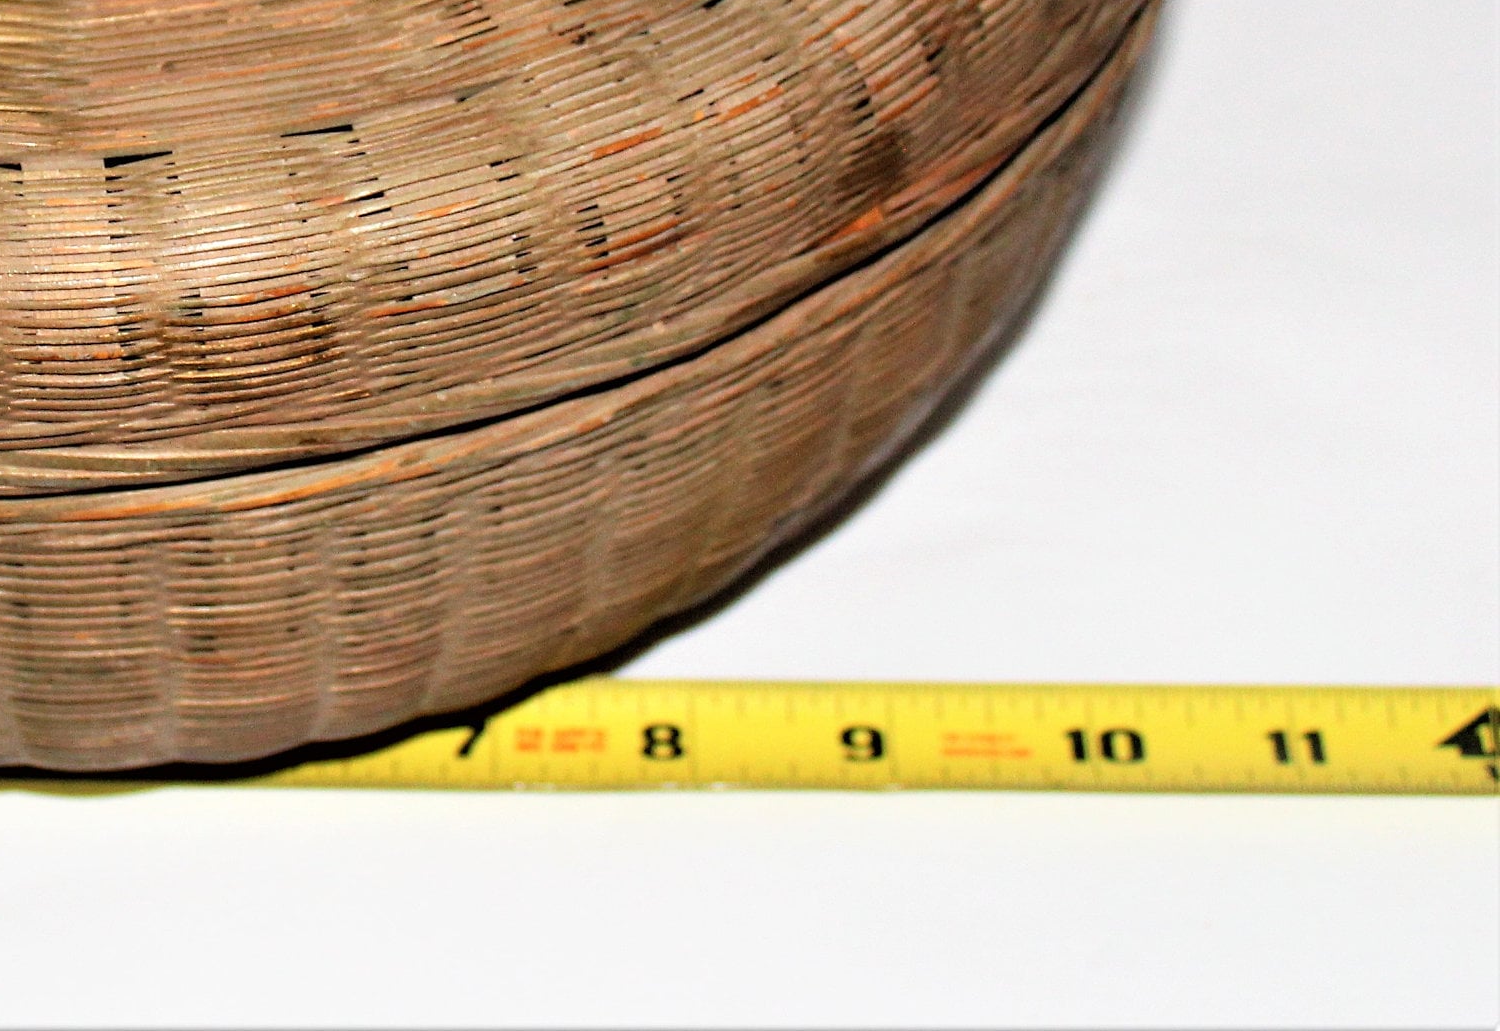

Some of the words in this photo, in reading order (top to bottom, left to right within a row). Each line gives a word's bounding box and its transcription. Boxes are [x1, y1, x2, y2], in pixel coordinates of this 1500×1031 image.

[642, 723, 684, 761] 8
[840, 724, 885, 762] 9
[1065, 727, 1145, 764] 10
[1265, 729, 1327, 765] 11
